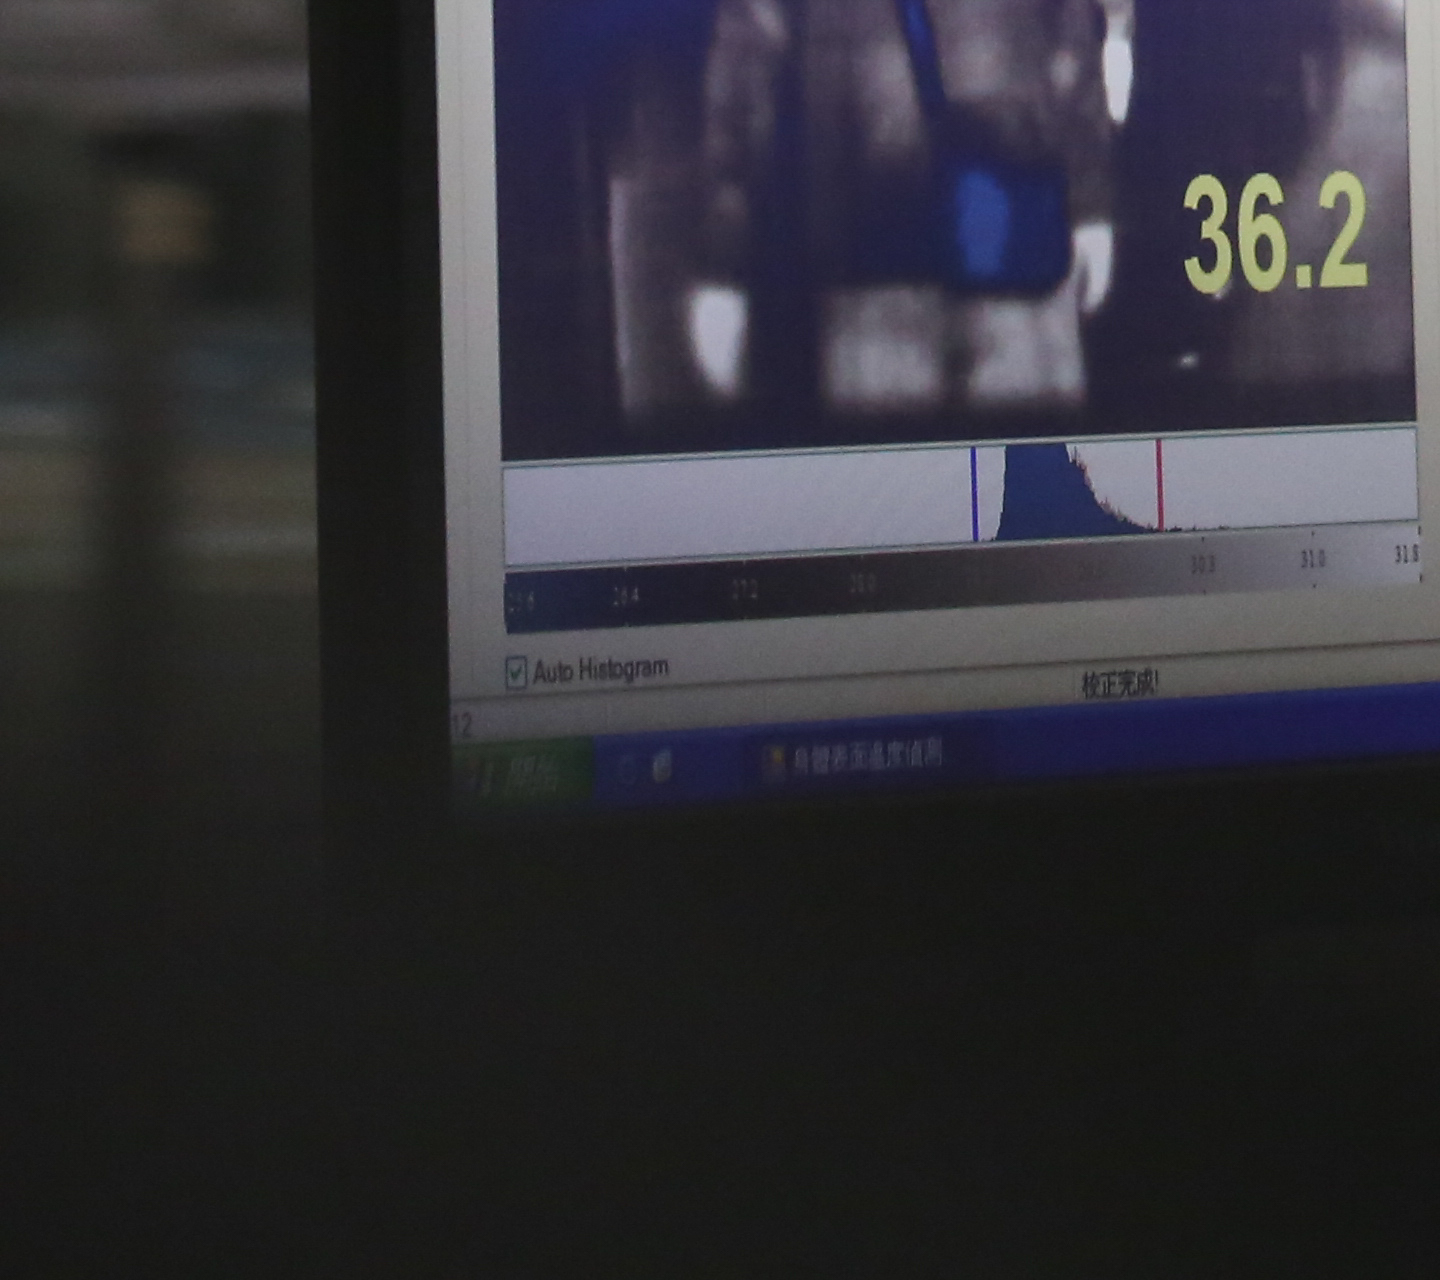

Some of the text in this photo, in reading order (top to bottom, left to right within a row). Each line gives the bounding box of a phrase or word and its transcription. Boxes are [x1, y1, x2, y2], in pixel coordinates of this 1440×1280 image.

[1183, 169, 1370, 295] 36.2
[532, 656, 671, 686] Auto Histogram
